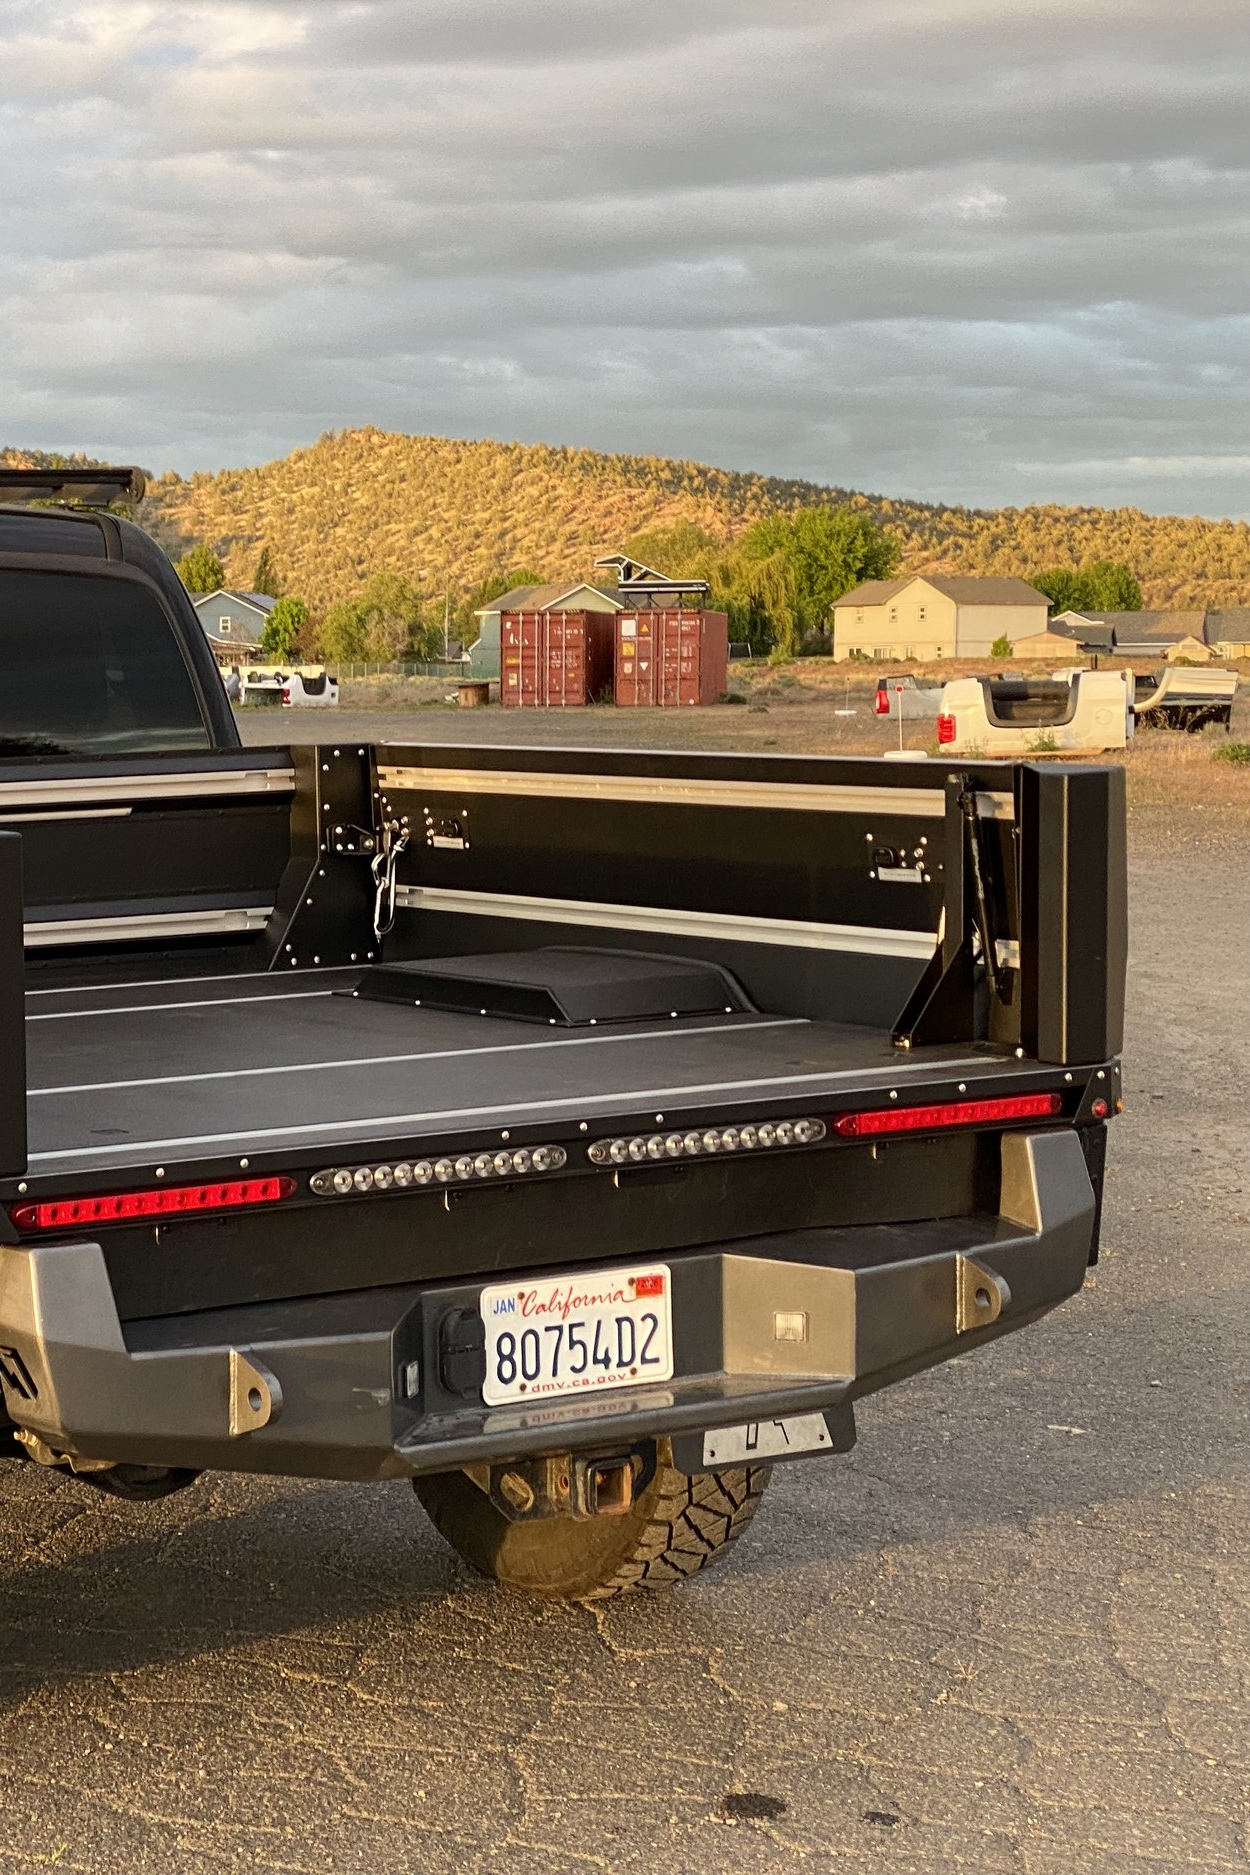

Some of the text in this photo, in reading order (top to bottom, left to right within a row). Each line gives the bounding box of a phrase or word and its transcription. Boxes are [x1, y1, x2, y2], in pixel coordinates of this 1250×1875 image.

[493, 1298, 516, 1315] JAN
[521, 1285, 636, 1321] California
[496, 1312, 661, 1386] 80754D2
[531, 1373, 627, 1393] dmv.ca.gov
